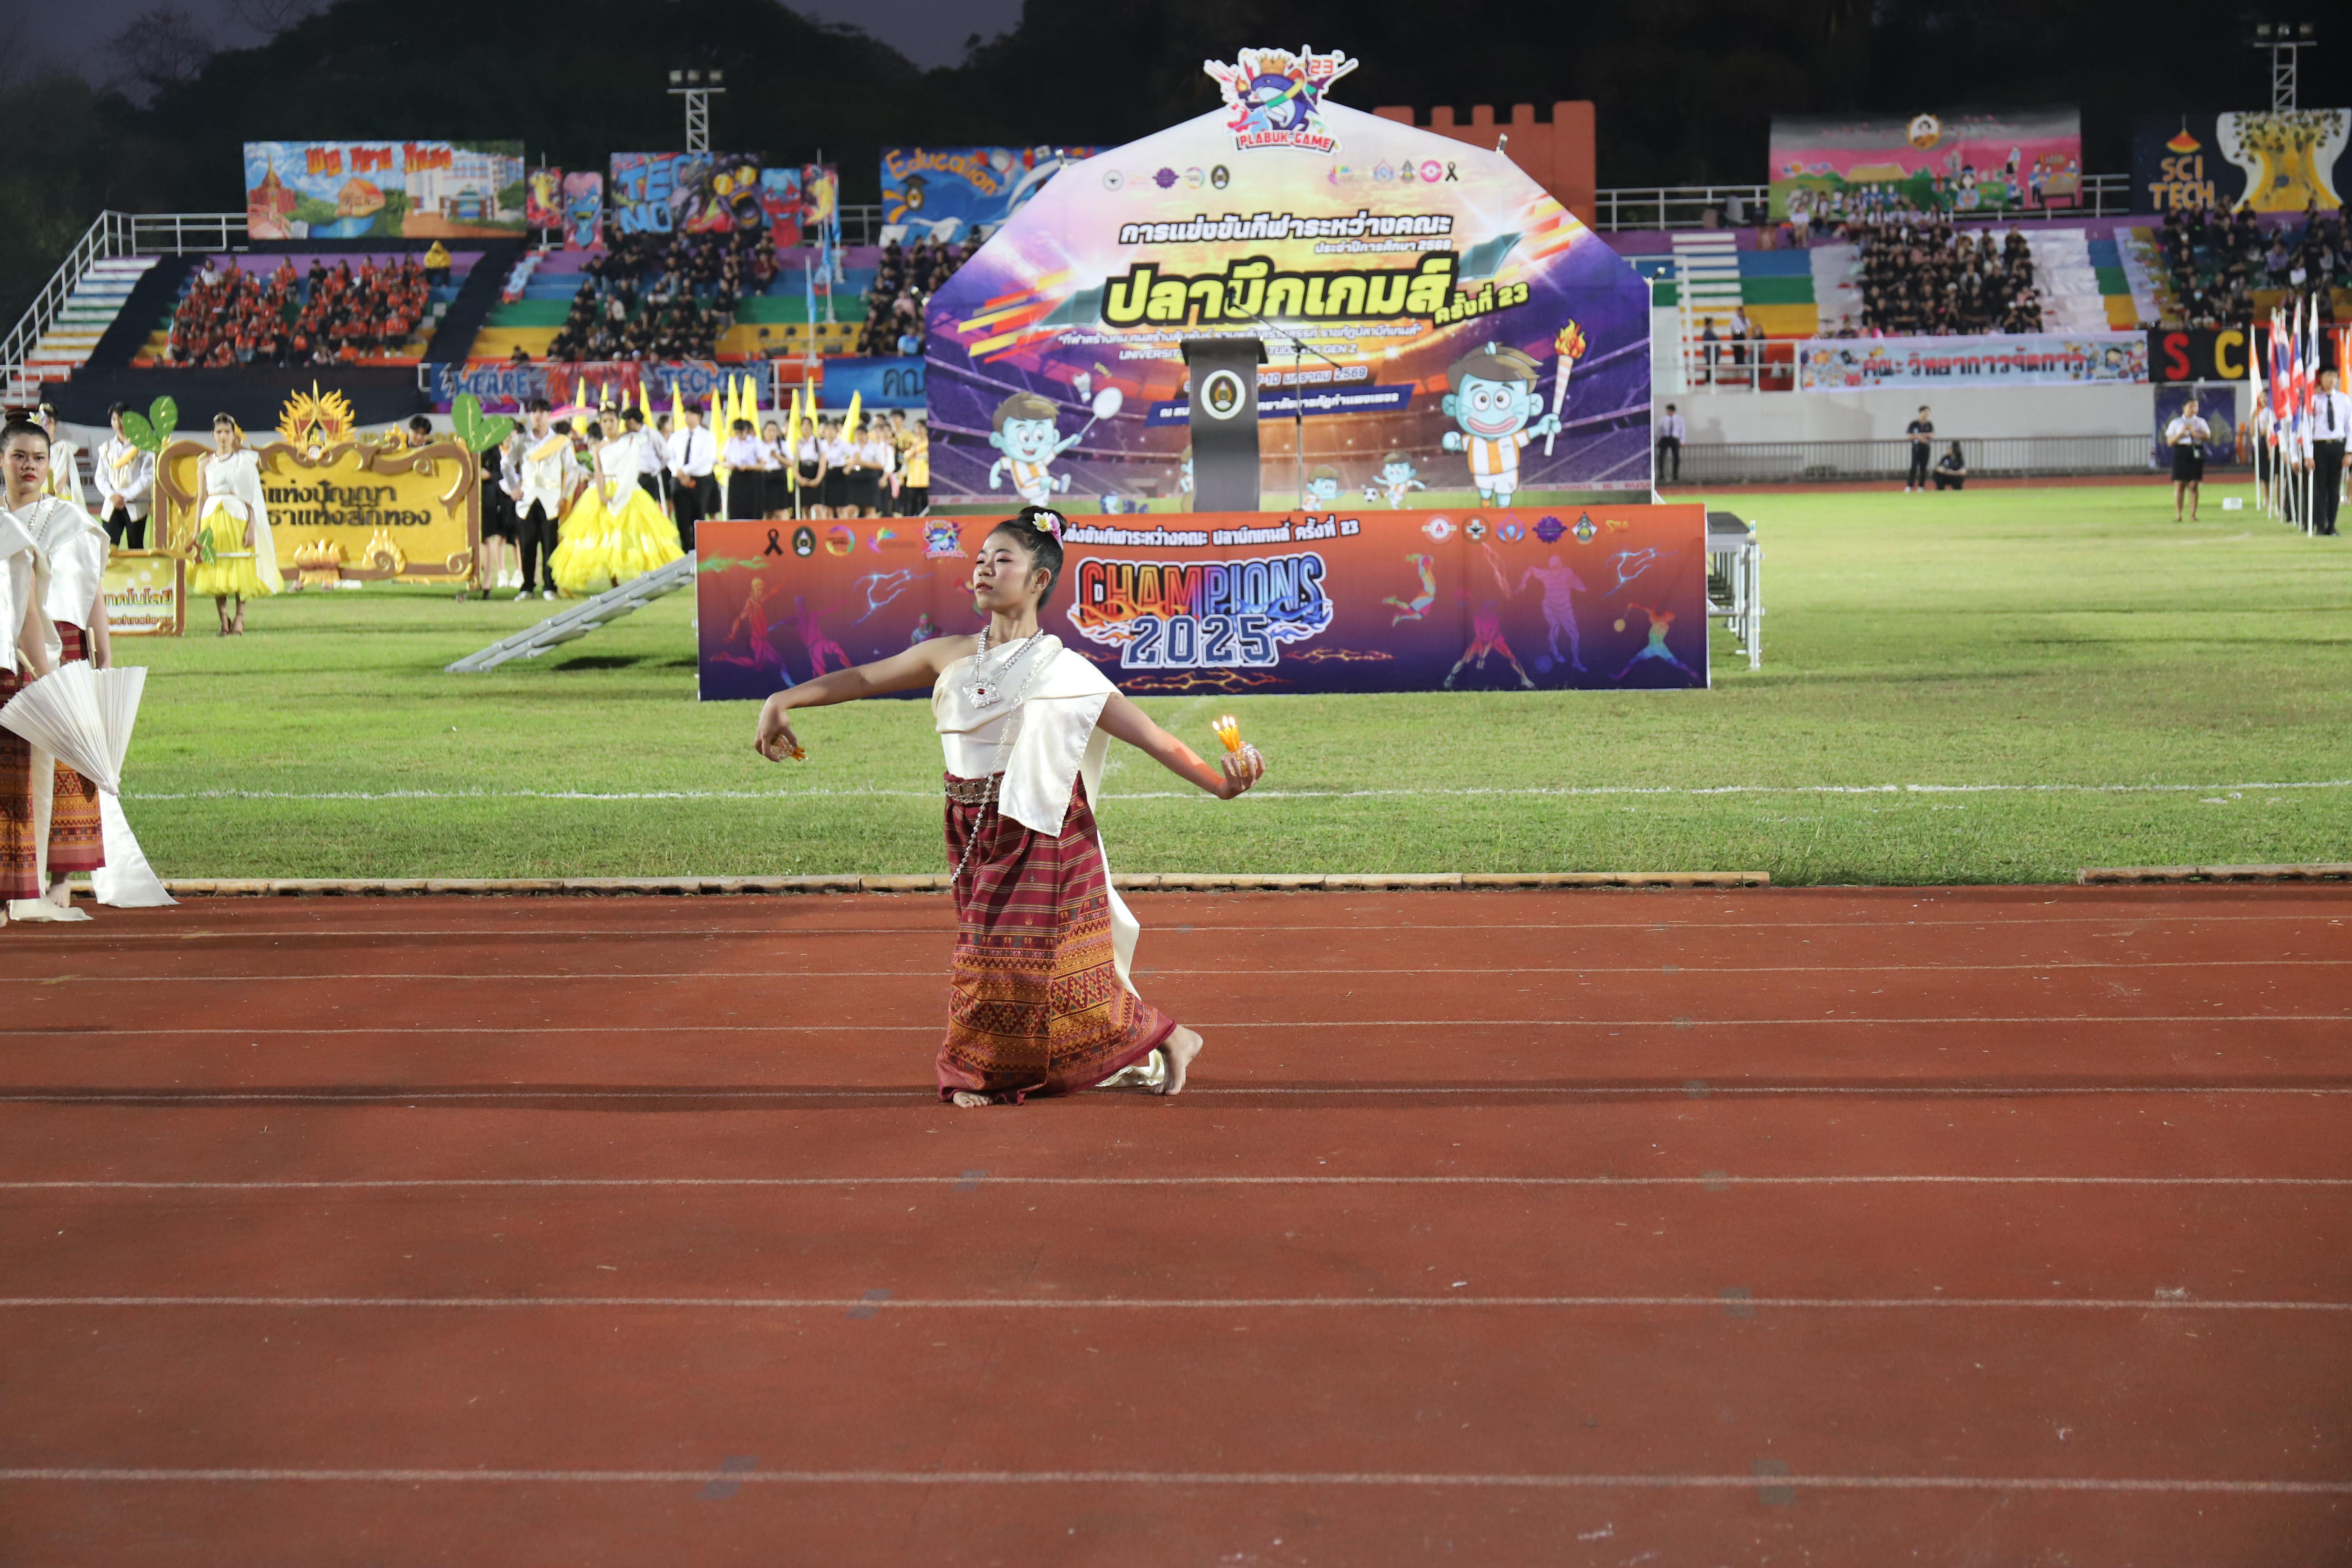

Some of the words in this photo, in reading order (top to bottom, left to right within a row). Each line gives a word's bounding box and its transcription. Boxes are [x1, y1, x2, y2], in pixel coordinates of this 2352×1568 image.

[1310, 59, 1334, 74] 23
[1295, 133, 1334, 149] GAME
[2161, 155, 2203, 182] SCI
[2149, 180, 2215, 210] TECH
[1119, 210, 1453, 244] การแข่งขันกีฬาระหว่างคณะ
[1434, 283, 1493, 325] ครั้งที่
[1498, 282, 1529, 308] 23
[1063, 522, 1208, 546] ข่งขันกีฬาระหว่างคณะ
[1294, 514, 1337, 541] ครั้งที่
[1340, 519, 1360, 537] 23
[105, 588, 173, 606] ทคโนโลยี
[1080, 554, 1324, 619] CHAMPIONS
[1121, 614, 1280, 669] 2025
